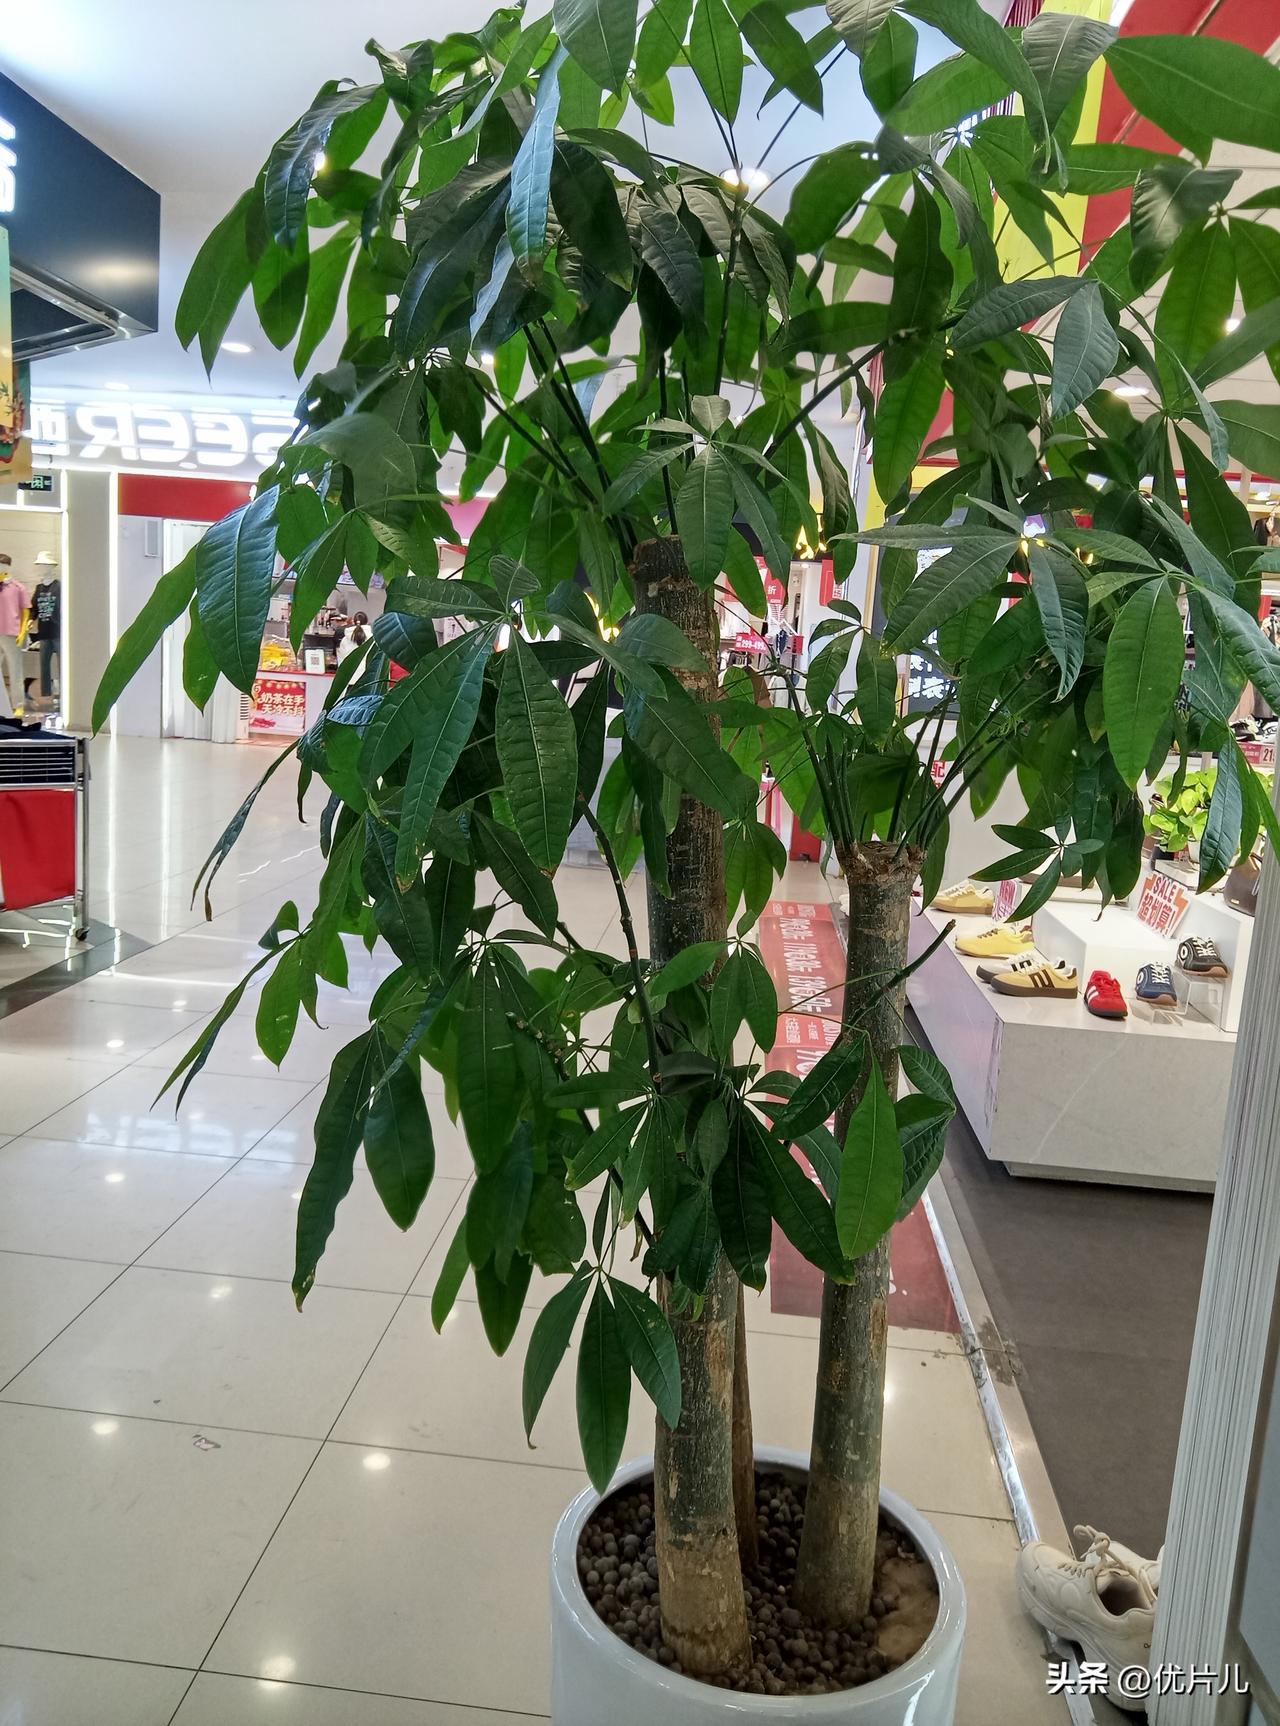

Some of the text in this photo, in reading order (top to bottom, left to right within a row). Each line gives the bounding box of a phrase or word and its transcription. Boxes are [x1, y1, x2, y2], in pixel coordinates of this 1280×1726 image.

[258, 692, 305, 706] 奶茶在手
[1263, 748, 1275, 762] 21
[1153, 876, 1177, 903] SALE
